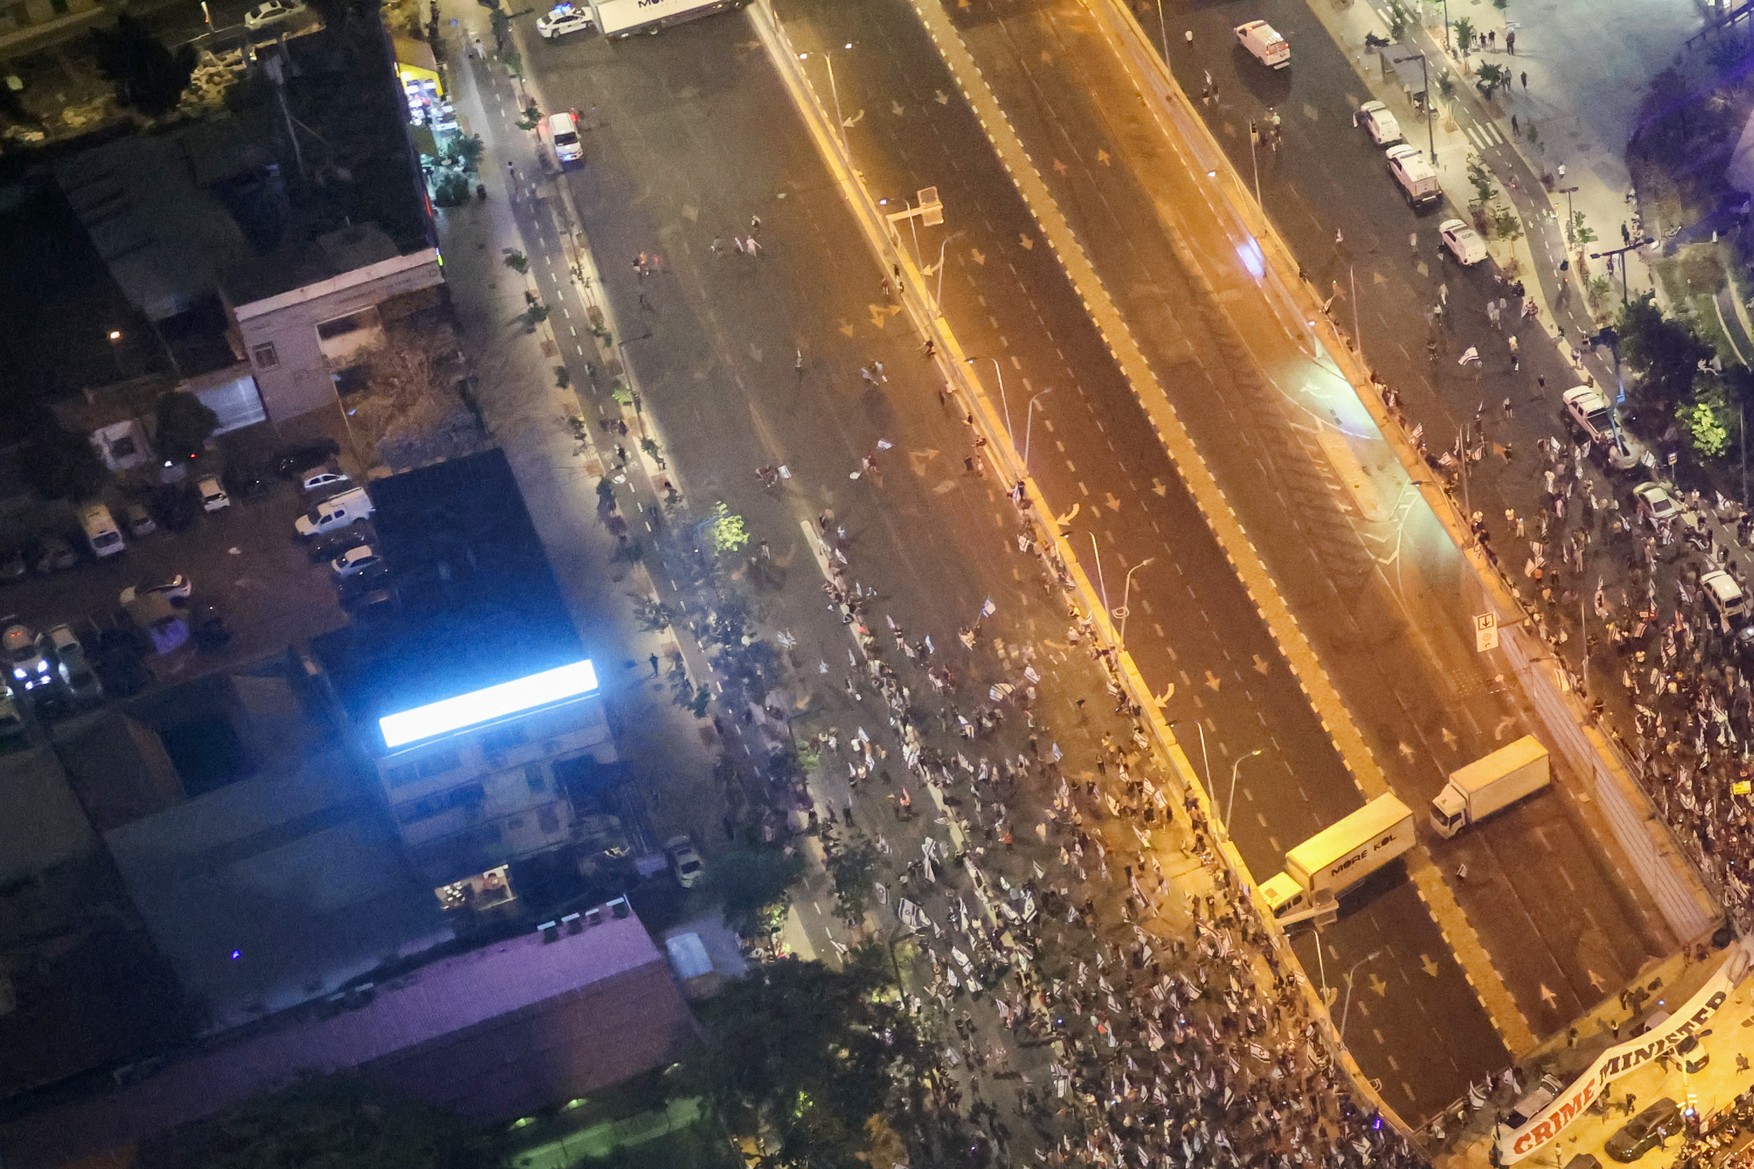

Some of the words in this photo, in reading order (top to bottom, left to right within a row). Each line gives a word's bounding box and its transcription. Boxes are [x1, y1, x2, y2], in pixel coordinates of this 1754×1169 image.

[1331, 849, 1368, 877] MORE
[1373, 834, 1397, 852] KOL
[1513, 1079, 1596, 1155] CRIME
